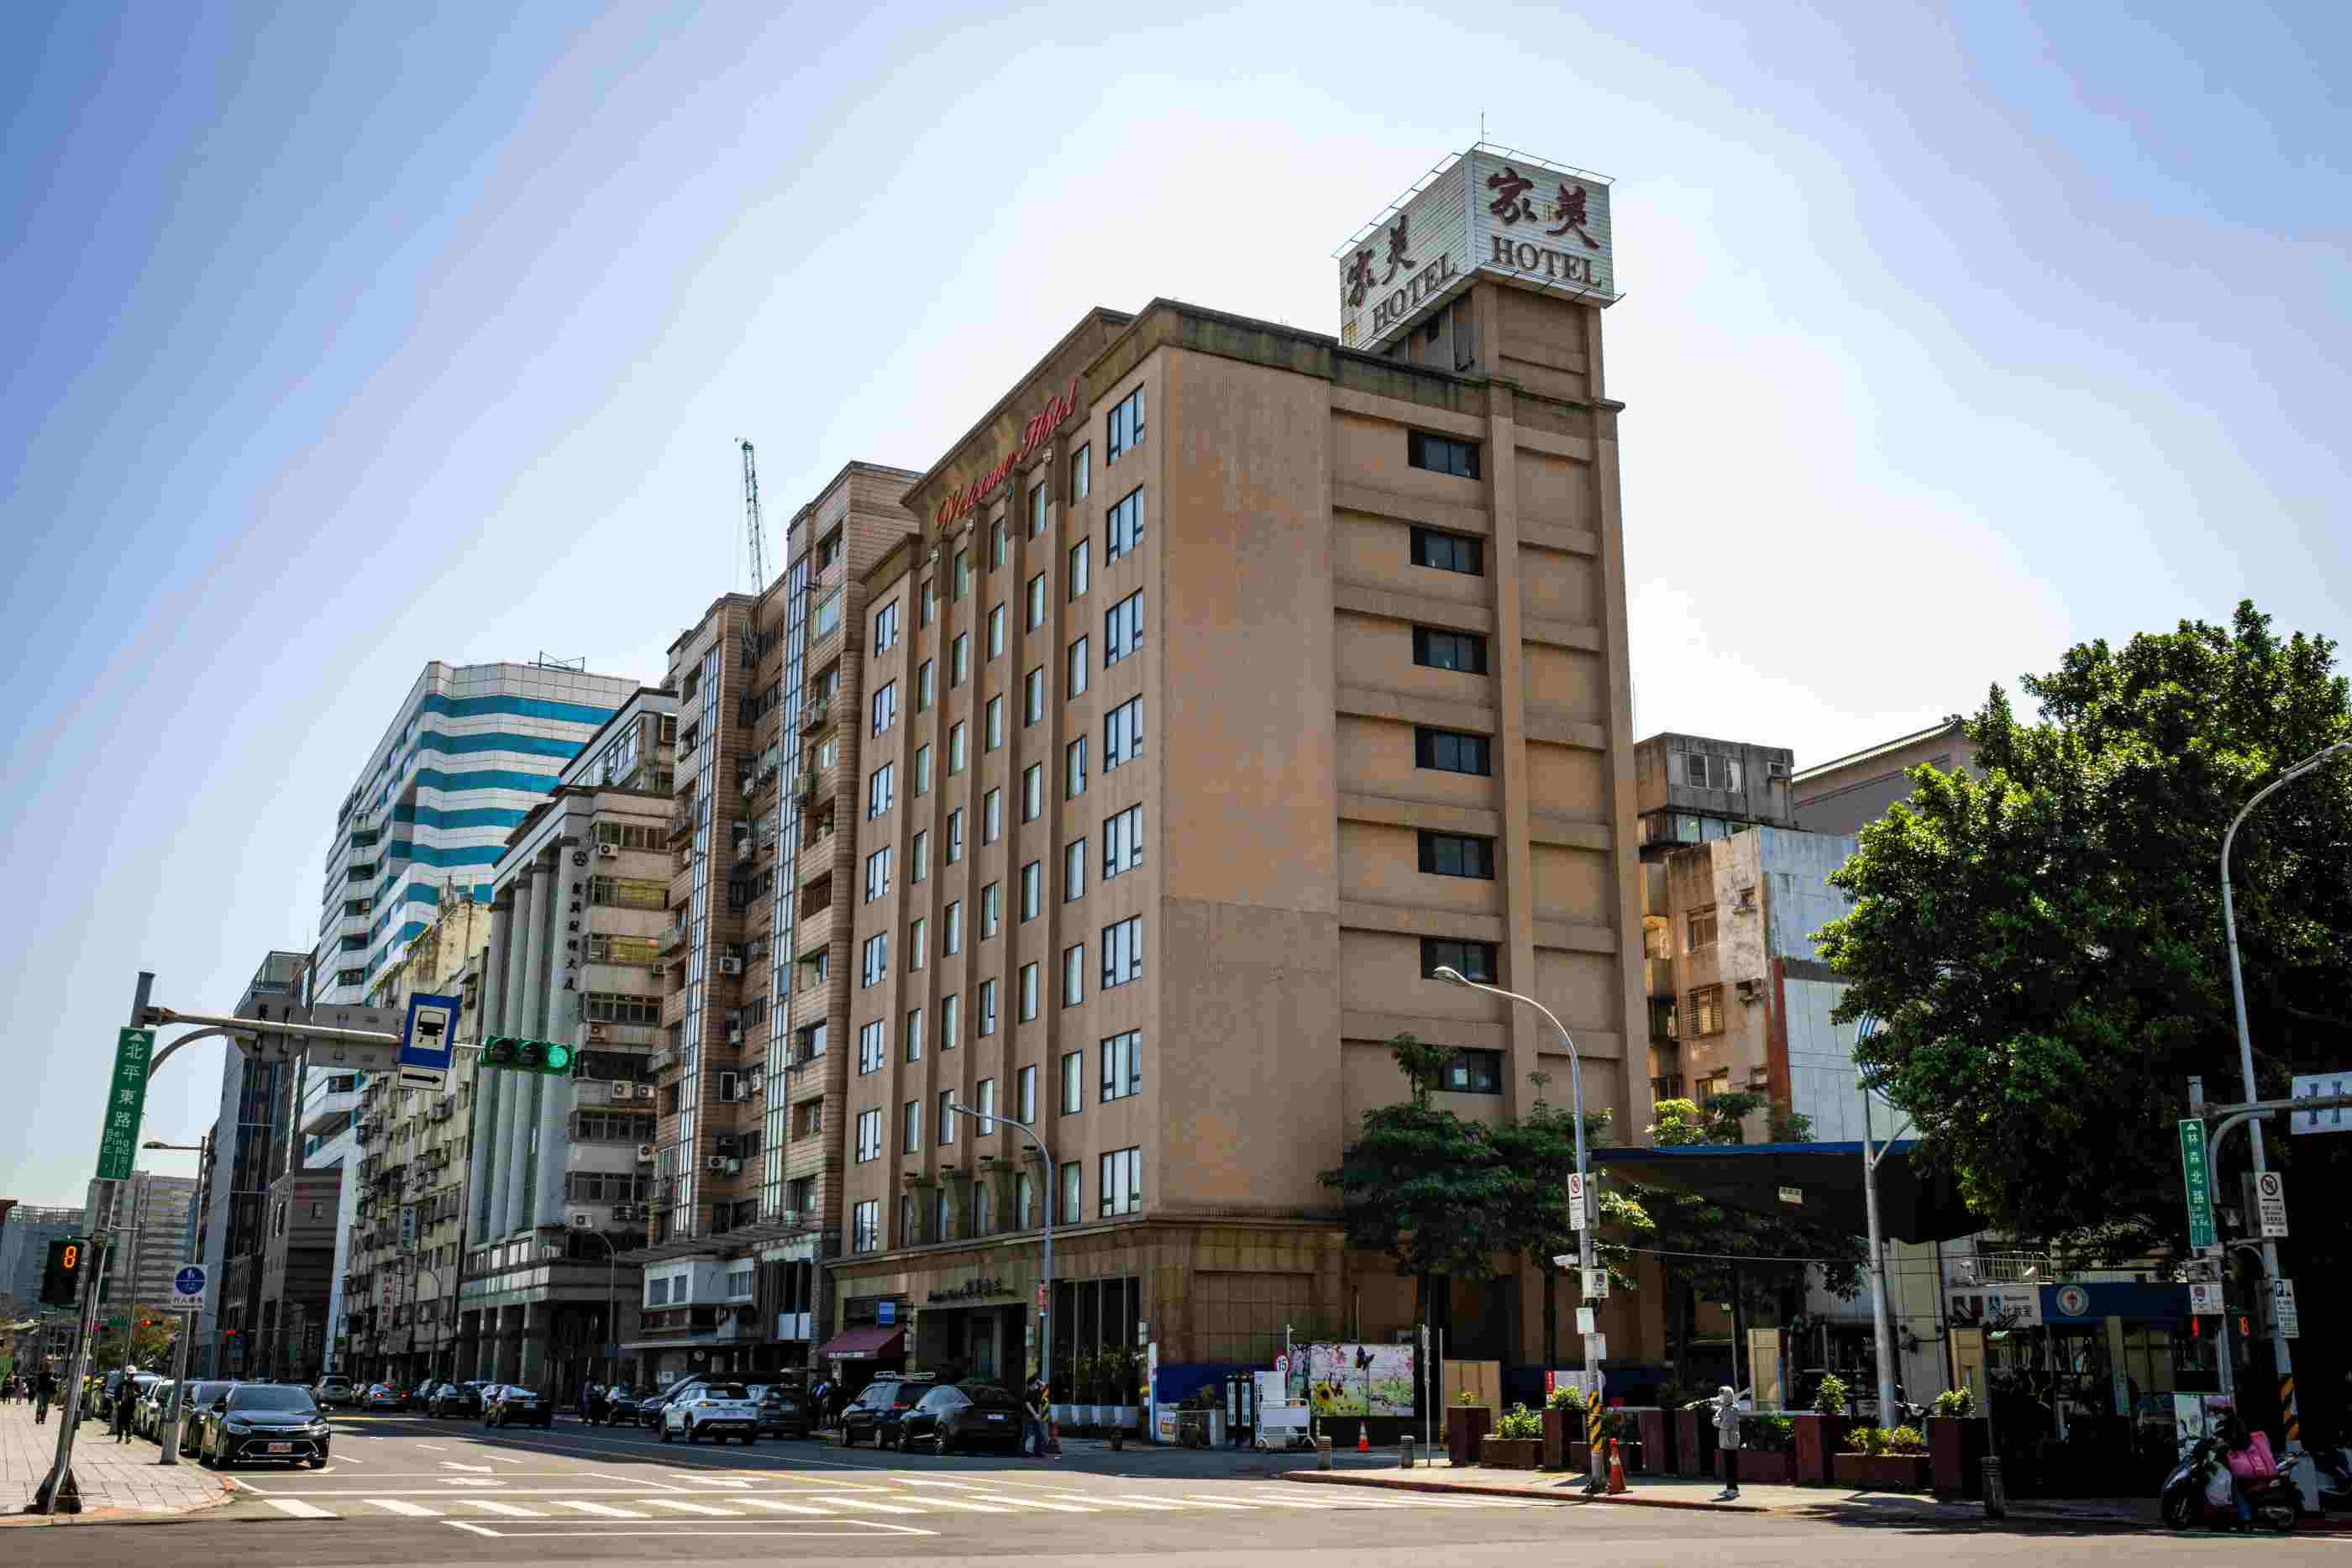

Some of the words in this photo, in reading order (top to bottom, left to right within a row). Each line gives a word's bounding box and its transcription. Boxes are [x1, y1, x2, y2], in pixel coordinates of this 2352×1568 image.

[1372, 253, 1458, 333] HOTEL
[1490, 234, 1603, 287] HOTEL
[114, 1043, 143, 1128] 北平東路
[2189, 1133, 2204, 1204] 林森北路
